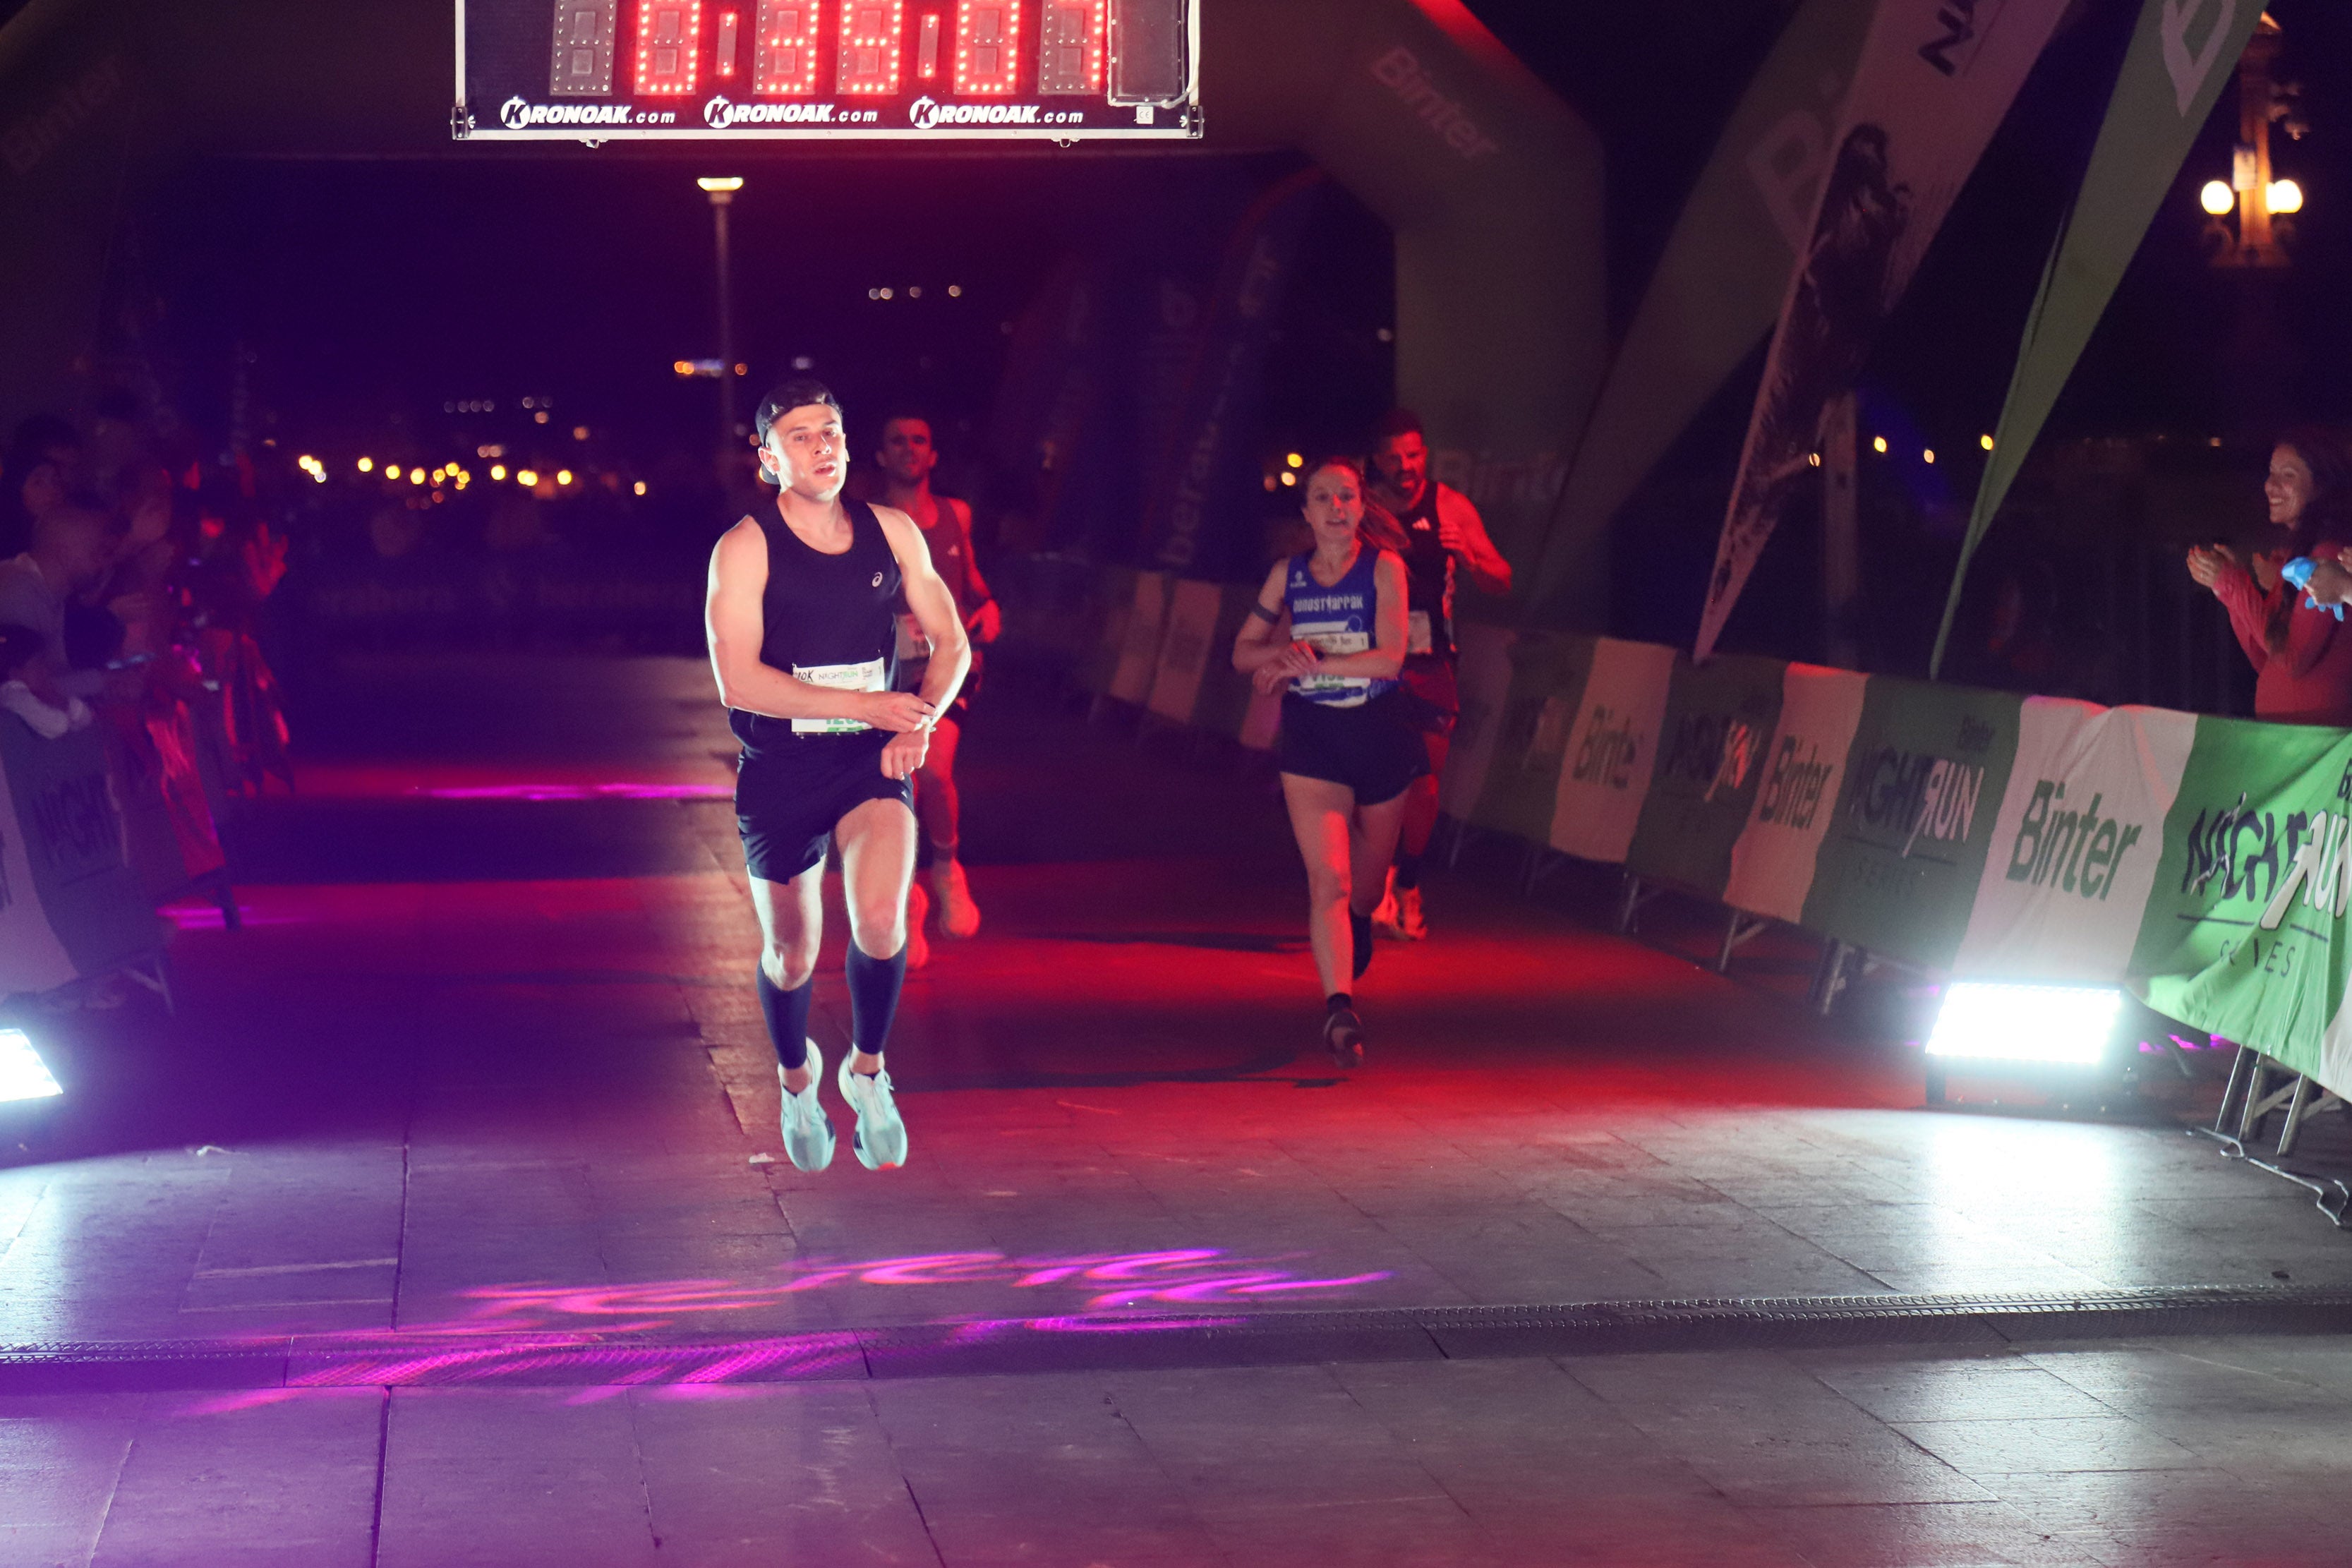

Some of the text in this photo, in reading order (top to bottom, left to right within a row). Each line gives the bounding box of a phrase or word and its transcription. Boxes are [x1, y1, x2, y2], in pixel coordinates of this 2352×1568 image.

[1370, 46, 1499, 159] Binter
[1761, 735, 1833, 830] Binter
[2006, 780, 2142, 902] Binter
